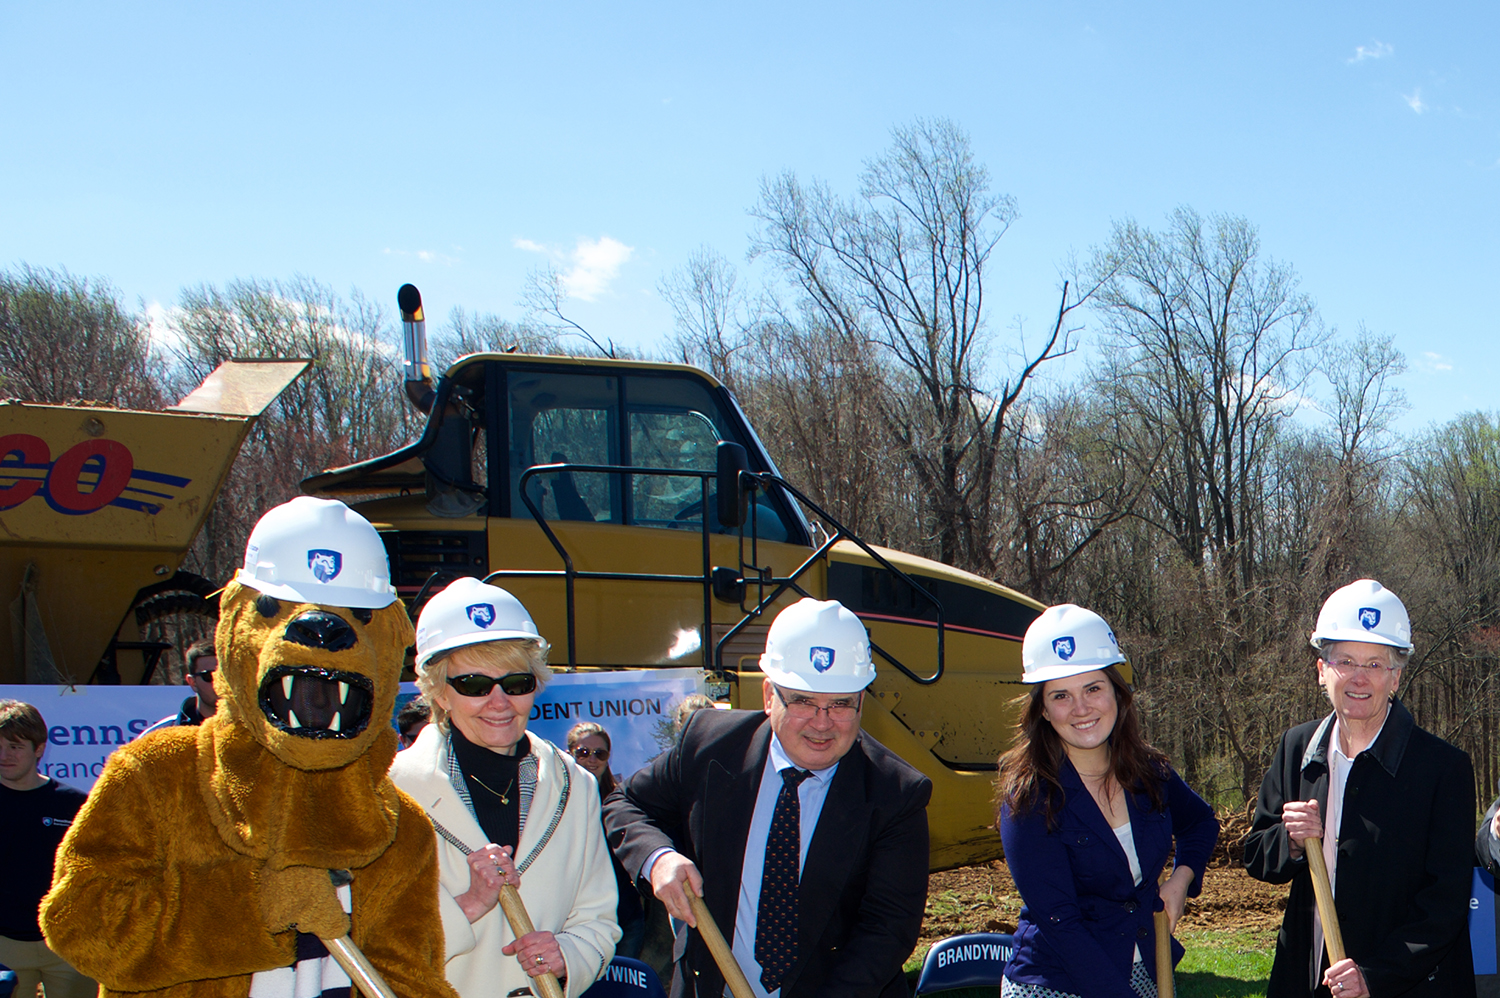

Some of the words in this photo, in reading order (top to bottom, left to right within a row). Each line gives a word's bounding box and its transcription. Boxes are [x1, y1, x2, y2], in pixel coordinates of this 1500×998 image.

[589, 698, 661, 718] UNION
[48, 719, 157, 746] ennS
[37, 756, 106, 778] rand
